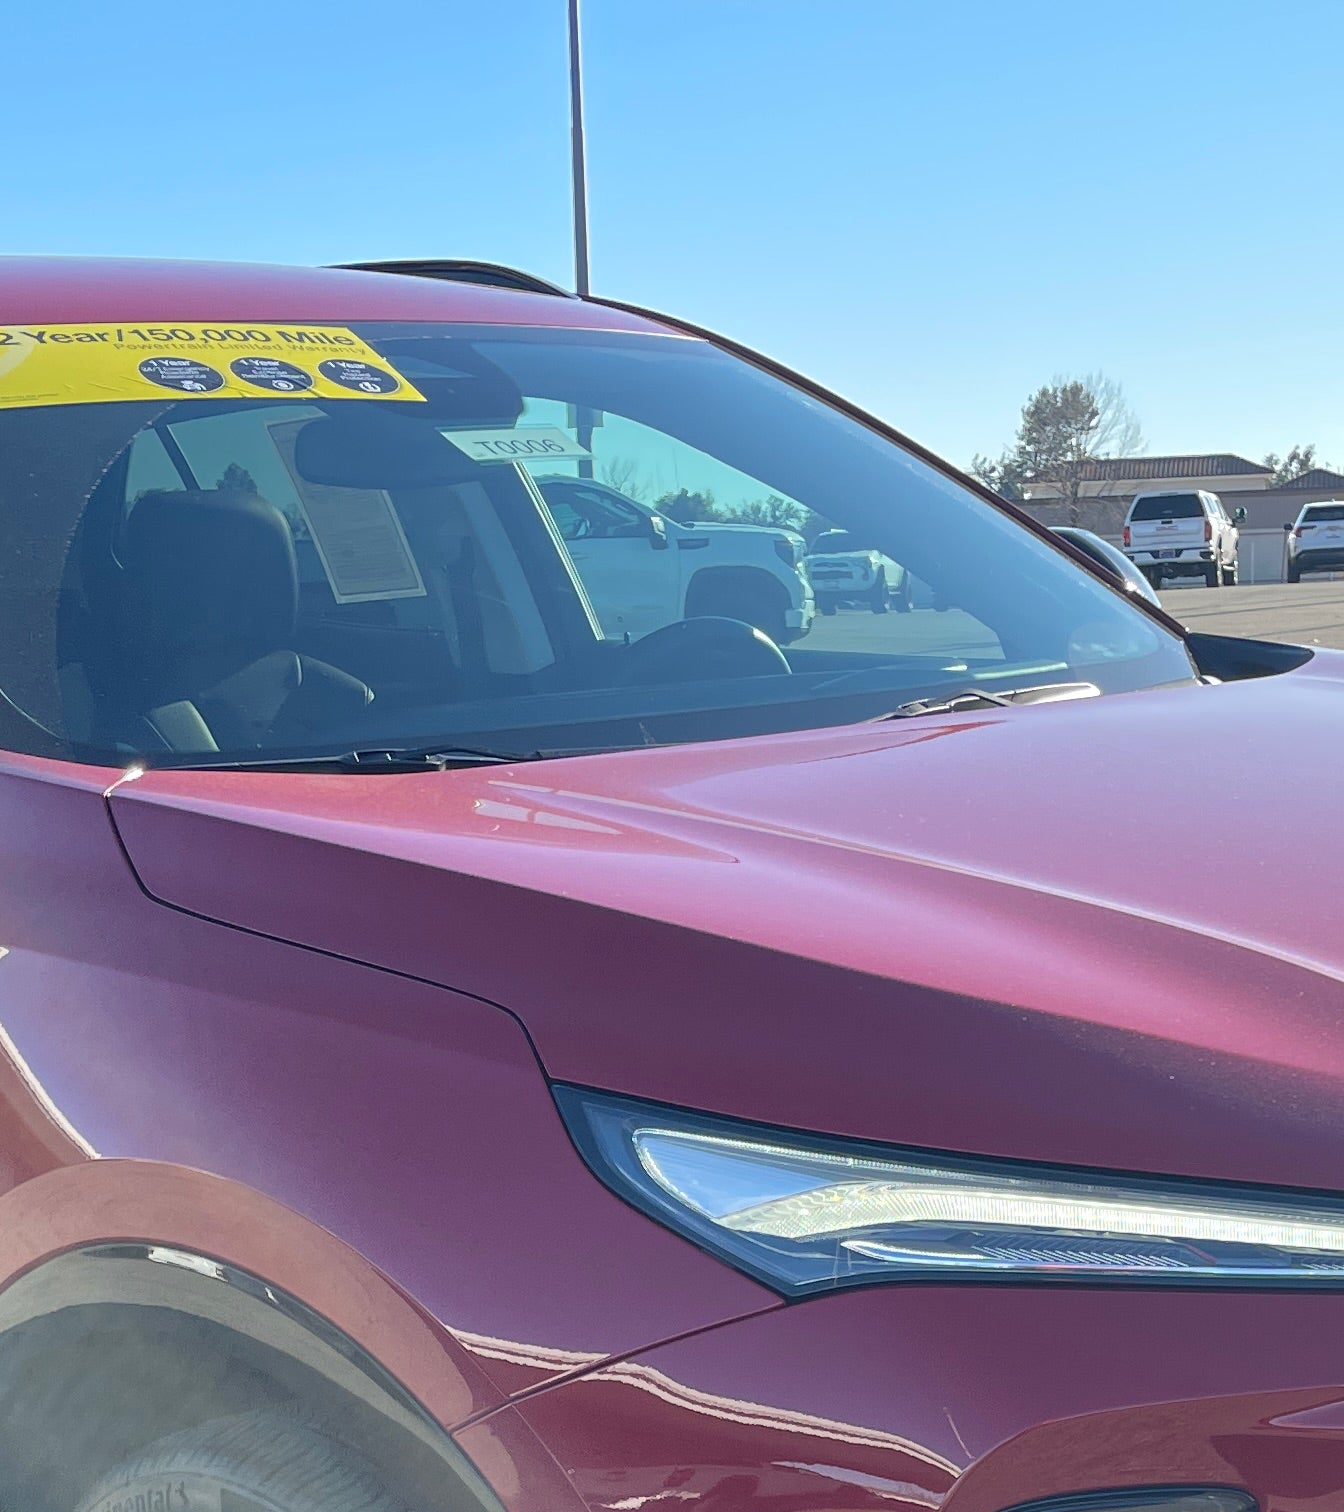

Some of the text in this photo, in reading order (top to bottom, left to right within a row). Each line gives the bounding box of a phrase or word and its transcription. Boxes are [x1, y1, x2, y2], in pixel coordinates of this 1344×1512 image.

[275, 329, 357, 347] Mile
[113, 342, 366, 356] Powertrain Limited Warranty
[158, 359, 191, 367] Year
[472, 439, 566, 456] T0006
